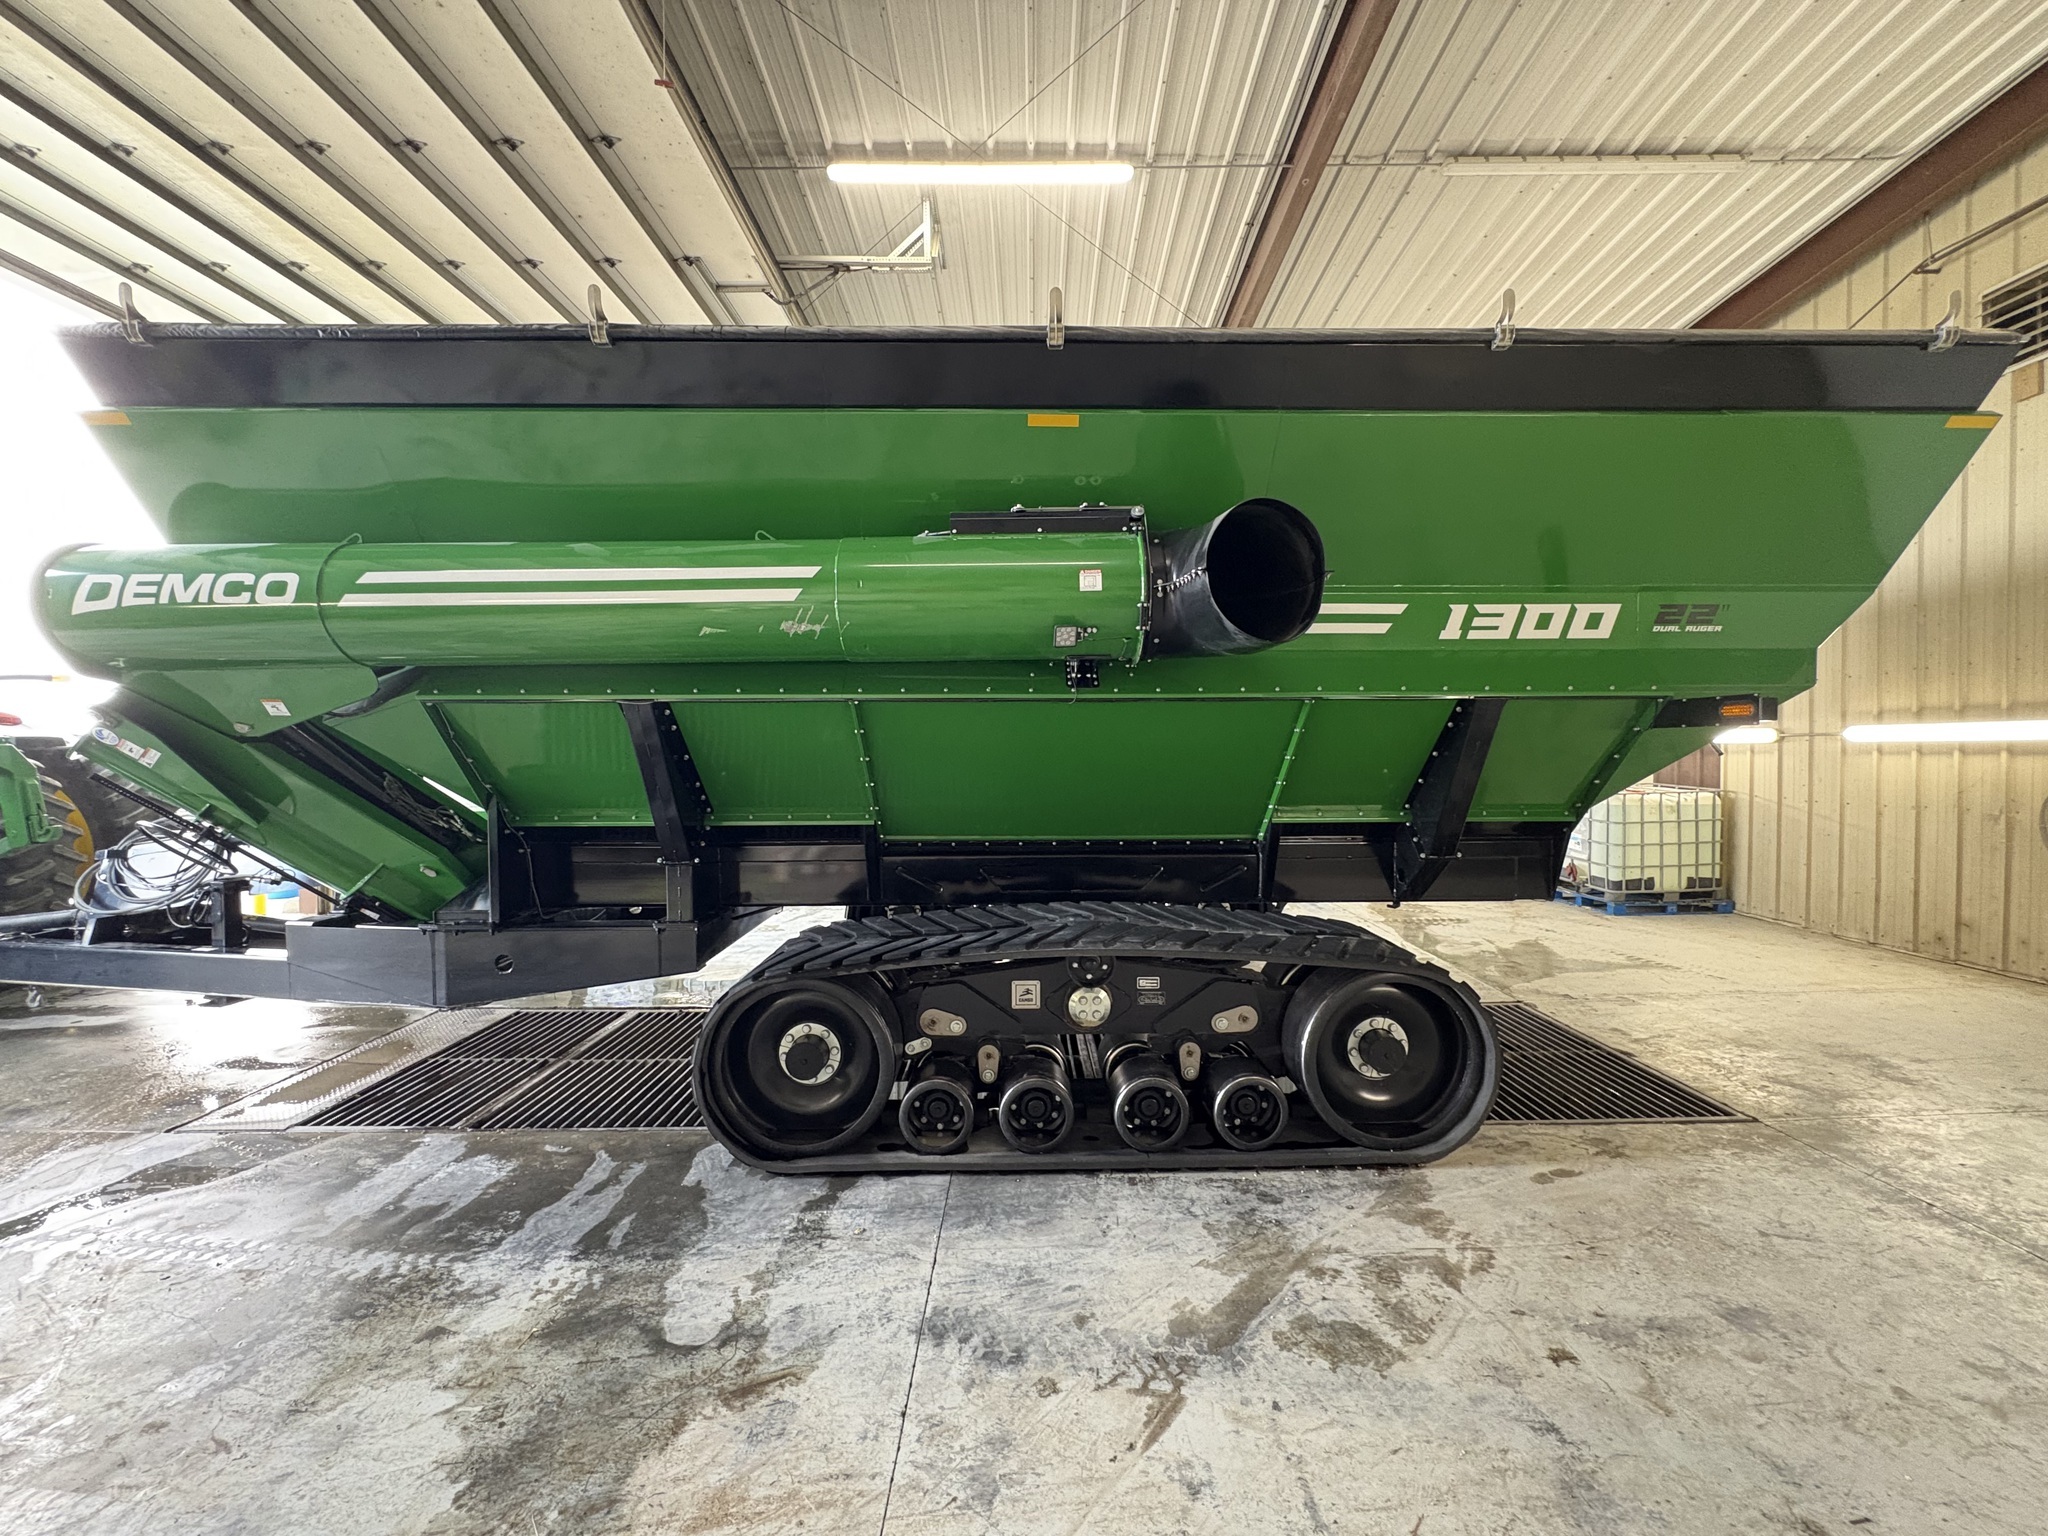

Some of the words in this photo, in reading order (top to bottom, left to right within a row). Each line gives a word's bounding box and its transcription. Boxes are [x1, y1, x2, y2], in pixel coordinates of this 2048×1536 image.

[71, 572, 300, 616] DEMCO
[1438, 603, 1622, 640] 1300
[1652, 625, 1682, 633] DUAL
[1684, 625, 1723, 633] AUGER
